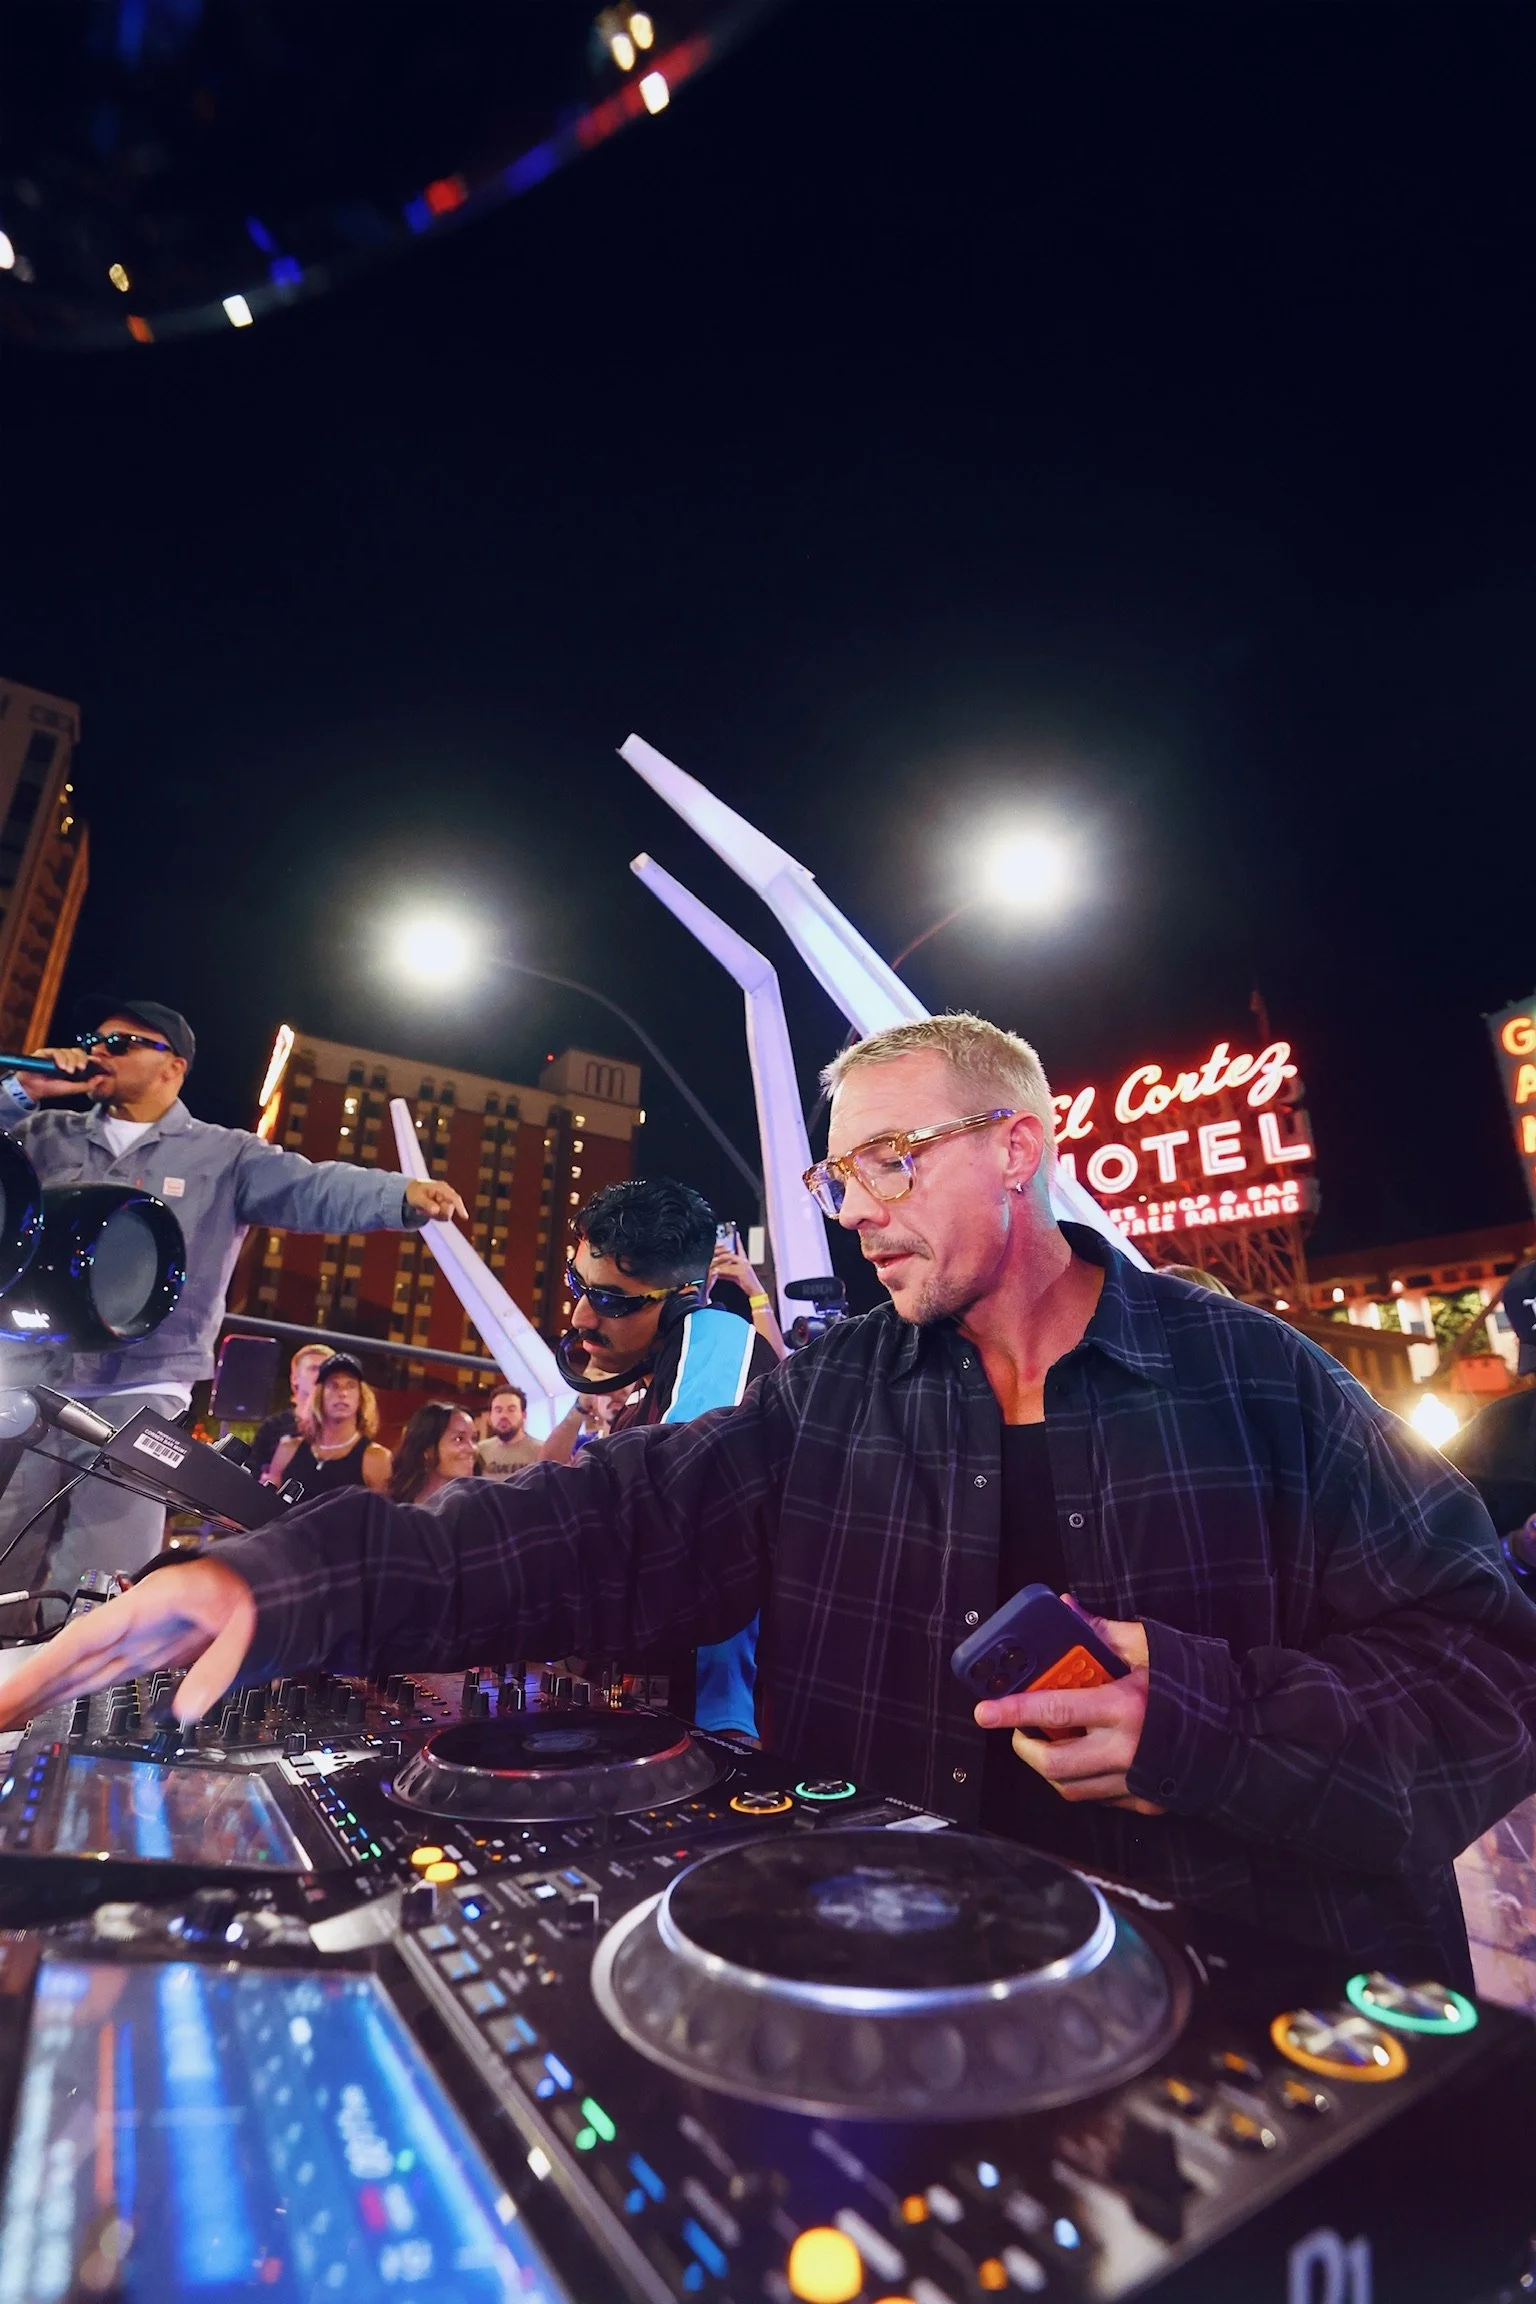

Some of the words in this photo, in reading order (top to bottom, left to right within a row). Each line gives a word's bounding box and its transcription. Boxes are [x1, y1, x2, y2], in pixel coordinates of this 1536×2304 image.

[1051, 1086, 1096, 1143] El
[1114, 1042, 1298, 1124] Cortez
[1118, 1214, 1175, 1237] FREE
[1185, 1194, 1299, 1228] PARKING
[1147, 1194, 1210, 1216] SHOP
[1246, 1180, 1299, 1201] BAR
